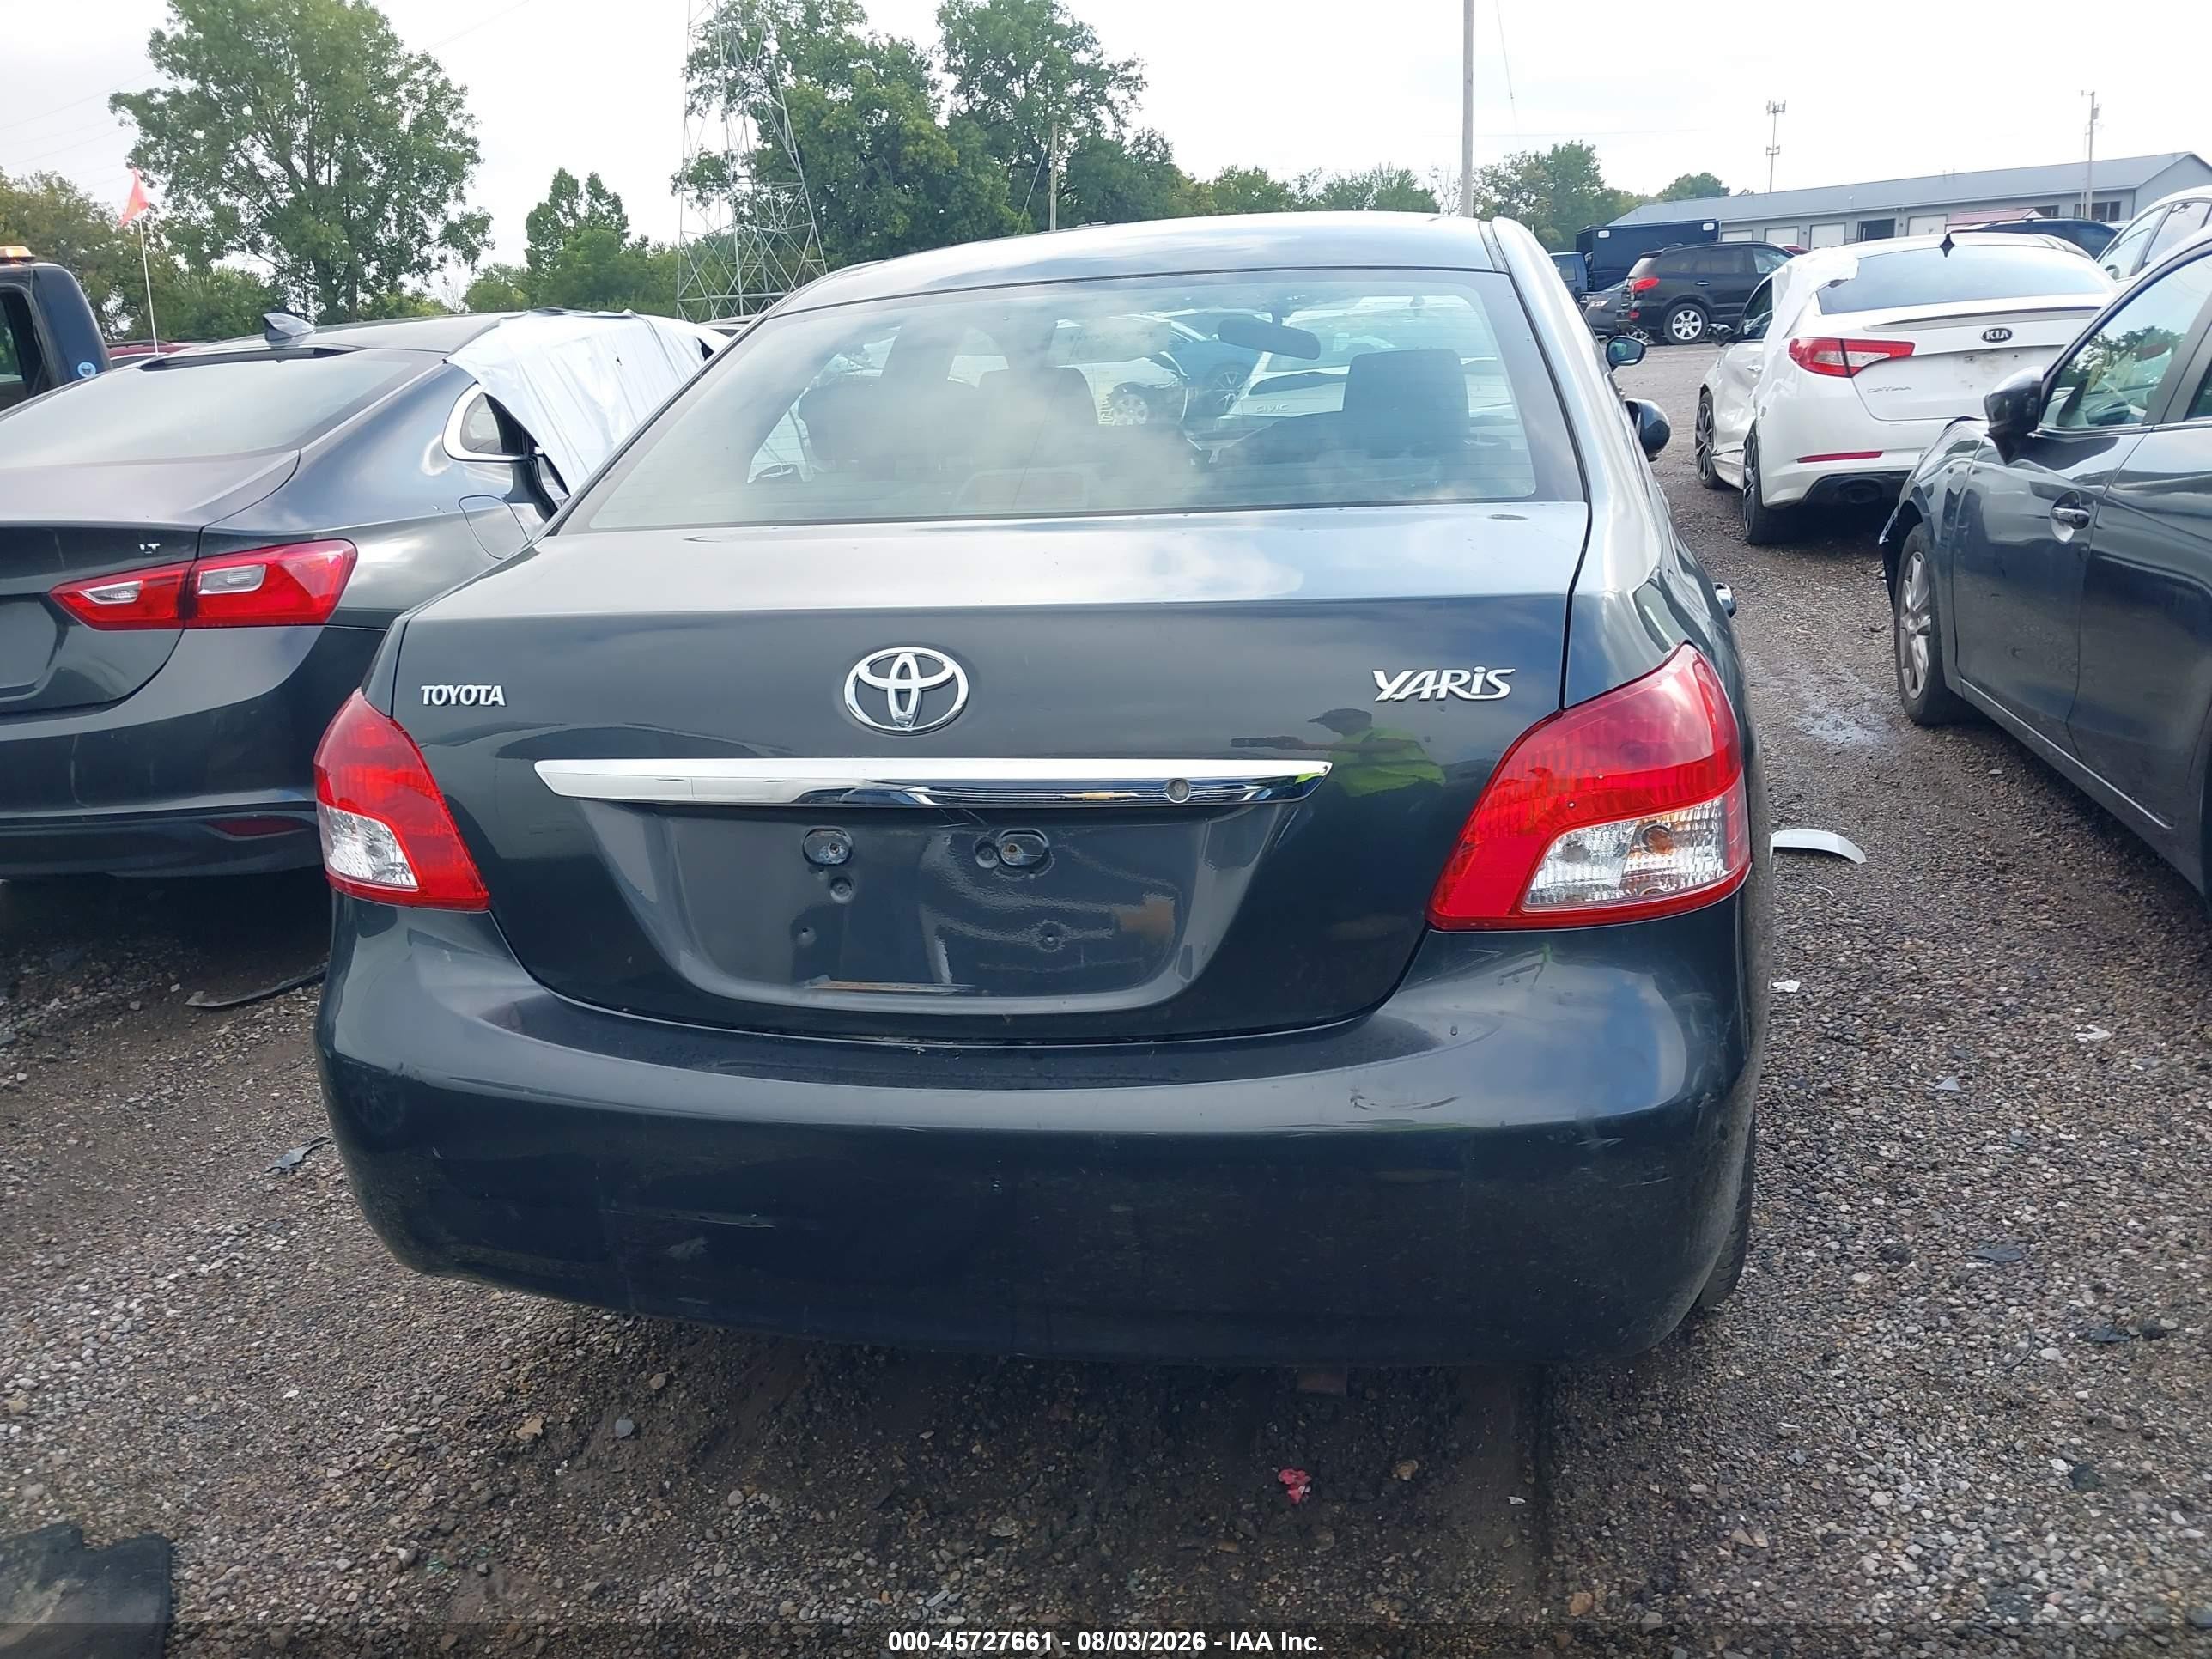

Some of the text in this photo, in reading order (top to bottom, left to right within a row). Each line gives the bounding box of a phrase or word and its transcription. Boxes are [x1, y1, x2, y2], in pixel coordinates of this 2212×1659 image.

[1985, 329, 2010, 340] KIA
[1256, 404, 1289, 413] CIVIC
[420, 684, 506, 706] TOYOTA
